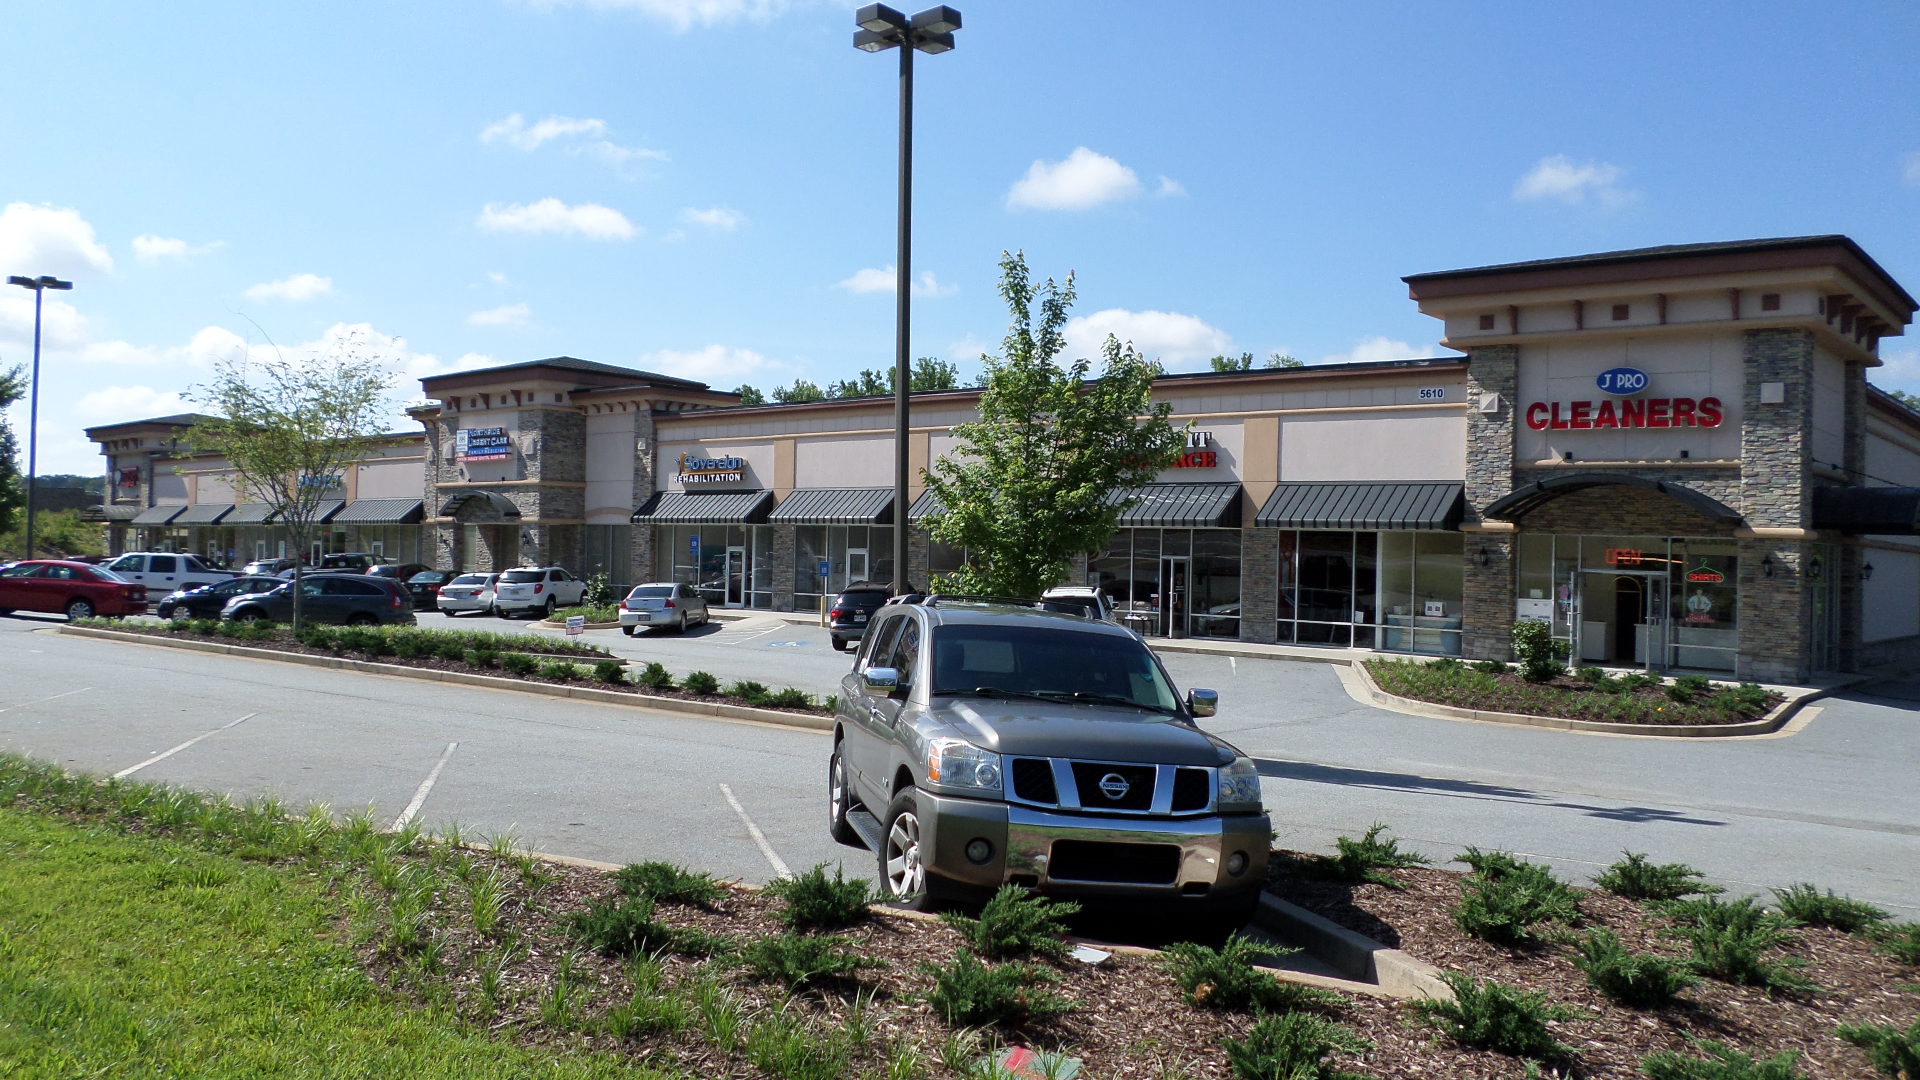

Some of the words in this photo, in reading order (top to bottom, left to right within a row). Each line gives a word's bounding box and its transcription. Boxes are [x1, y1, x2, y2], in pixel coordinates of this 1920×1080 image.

[1600, 373, 1612, 388] J
[1617, 373, 1644, 388] PRO
[1420, 388, 1444, 398] 5610
[1526, 397, 1723, 431] CLEANERS
[491, 436, 508, 446] CARE
[684, 455, 743, 470] Sovereign
[674, 473, 741, 483] REHABILITATION
[1605, 548, 1641, 565] OPEN
[1688, 573, 1722, 582] SHIRTS
